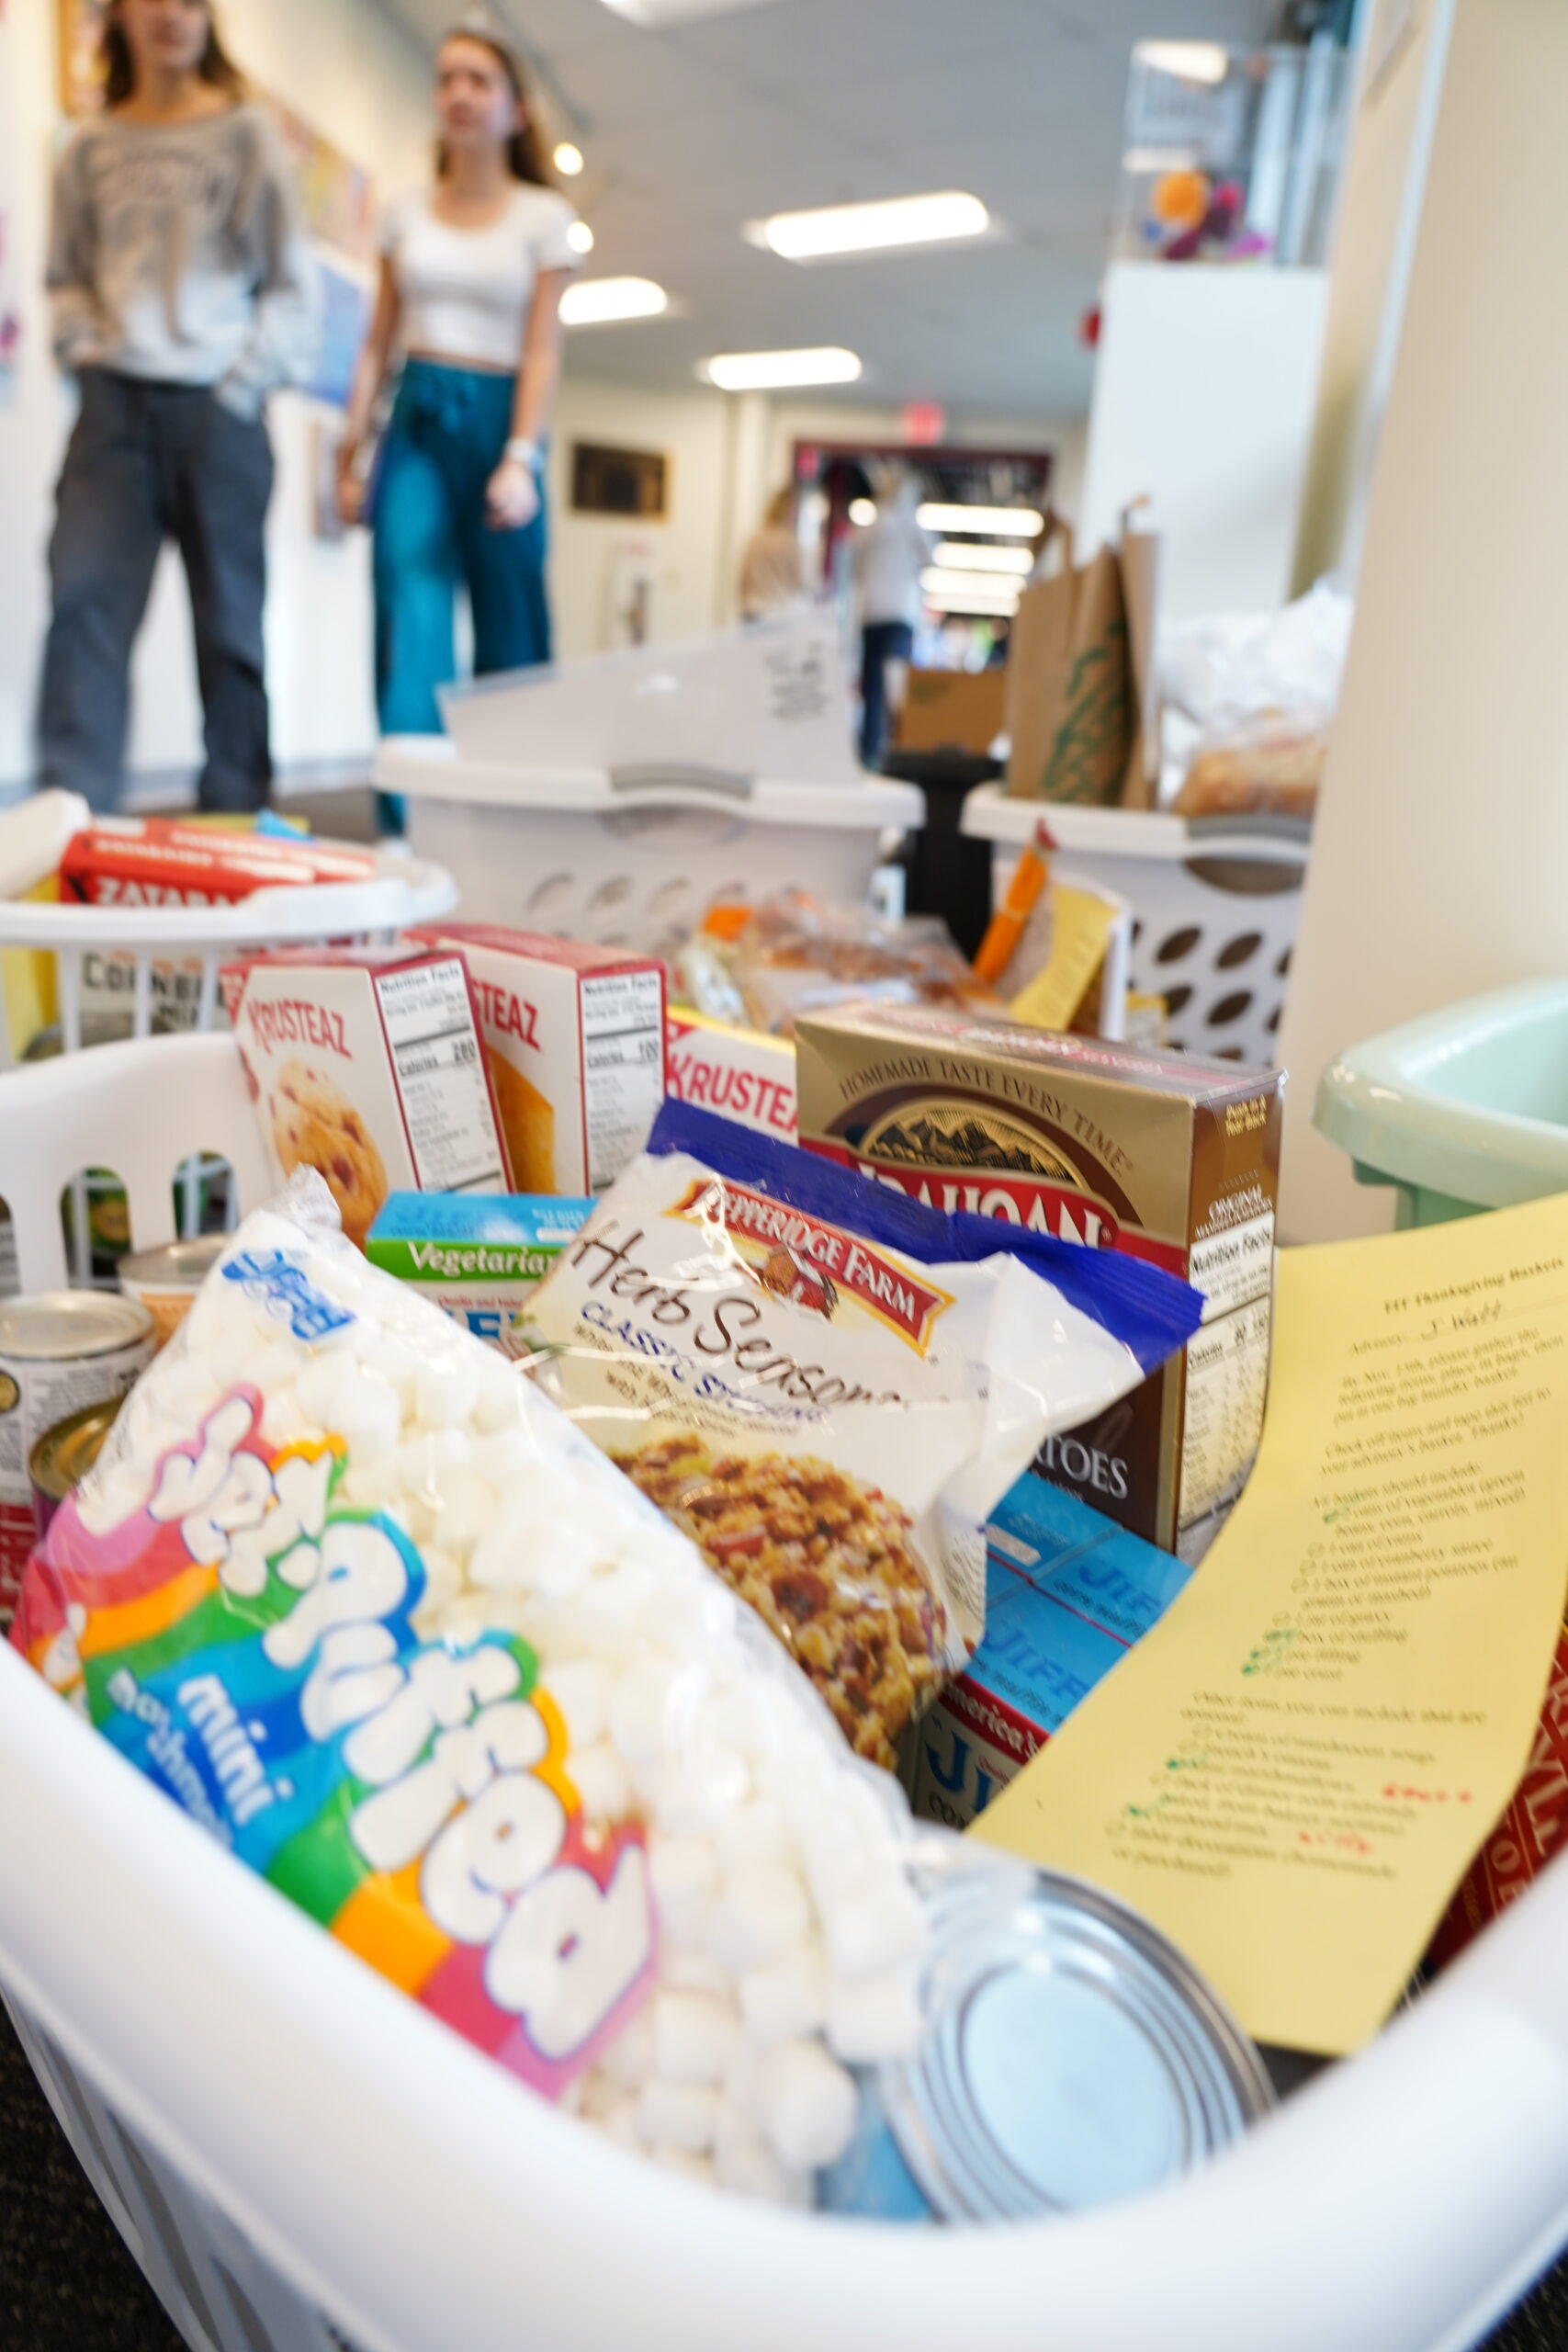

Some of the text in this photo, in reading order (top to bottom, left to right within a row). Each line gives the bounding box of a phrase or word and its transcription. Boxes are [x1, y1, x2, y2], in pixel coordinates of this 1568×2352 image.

[248, 998, 353, 1059] KRUSTEAZ
[840, 1058, 931, 1100] HOMEMADE
[939, 1059, 996, 1089] TASTE
[1002, 1075, 1068, 1122] EVERY
[571, 1220, 691, 1325] Herb
[842, 1241, 915, 1323] FARM
[177, 1672, 295, 1826] mini
